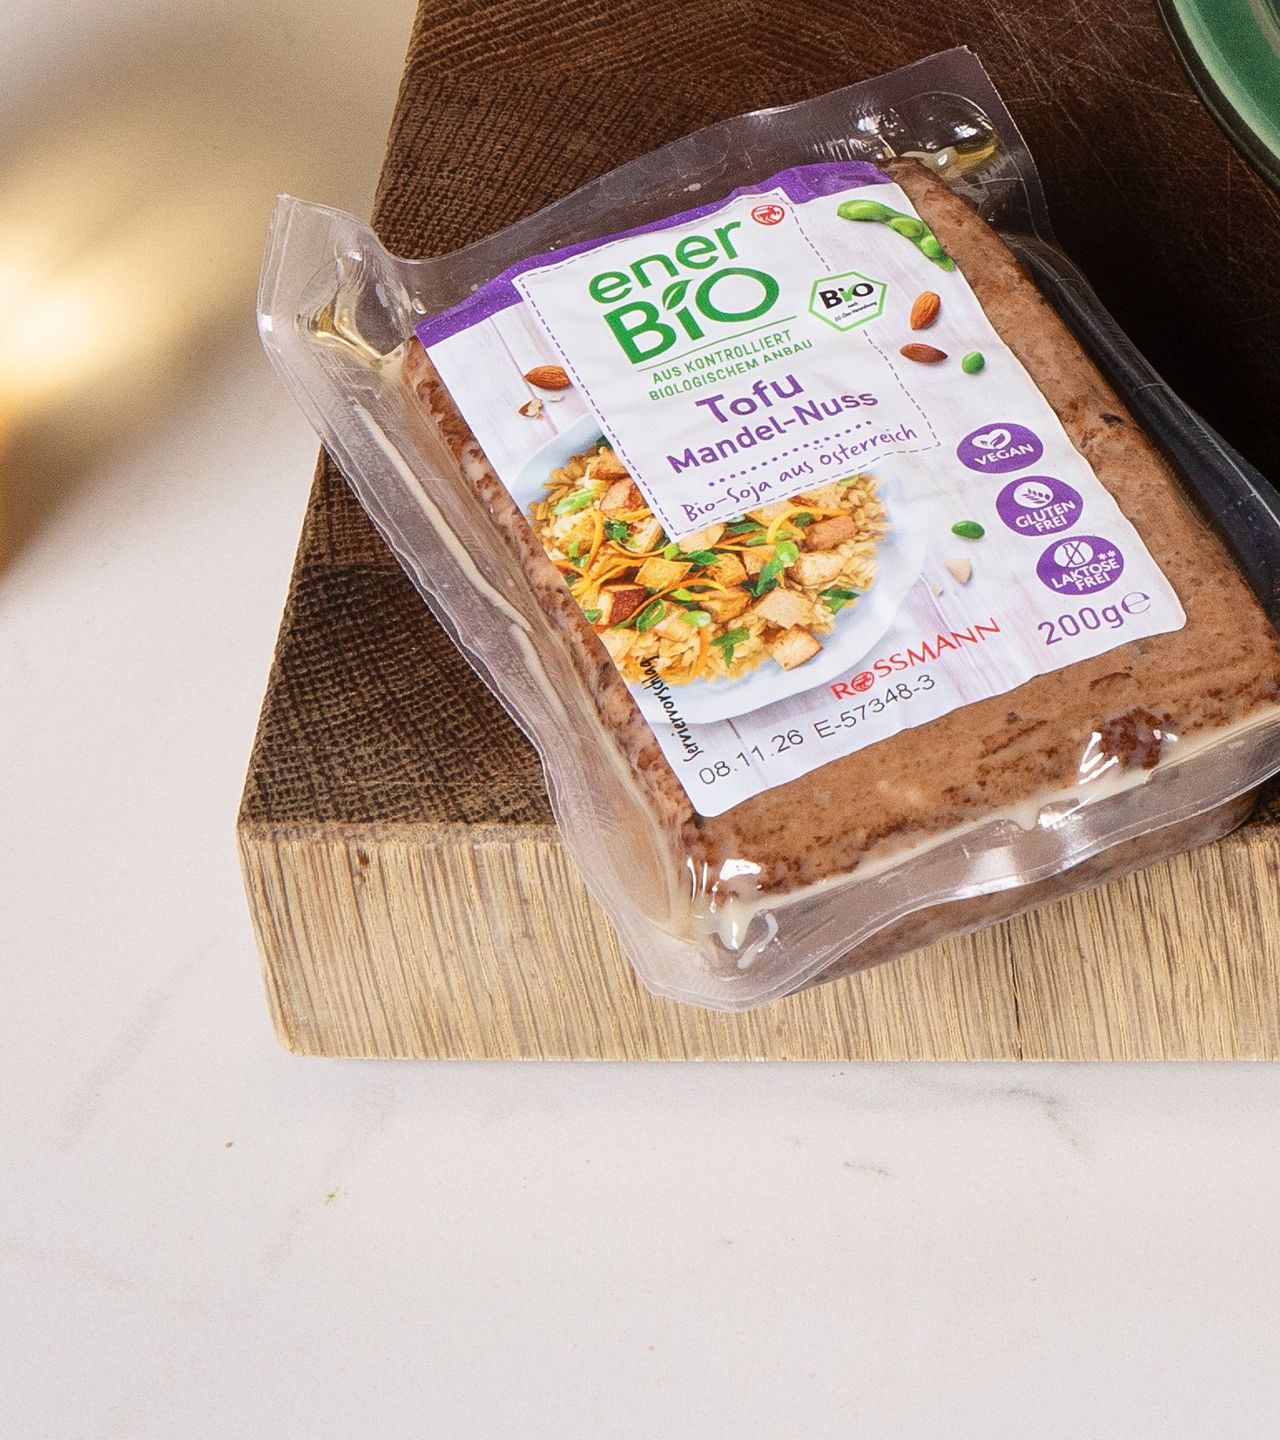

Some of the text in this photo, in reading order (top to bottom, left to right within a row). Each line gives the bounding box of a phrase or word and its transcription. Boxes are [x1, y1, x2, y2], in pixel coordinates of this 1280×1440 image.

[588, 221, 742, 304] ener
[648, 338, 813, 401] BIOLOGISCHEM ANBAU
[652, 329, 794, 385] AUS KONTROLLIERT
[695, 373, 805, 424] Tofu
[666, 392, 879, 474] Mandel-Nuss
[974, 443, 1035, 466] VEGAN
[681, 481, 773, 523] Bio-Soja
[779, 460, 815, 483] aus
[1015, 500, 1076, 529] GLUTEN
[1035, 516, 1068, 533] FREI
[1074, 573, 1110, 592] FREI
[638, 655, 706, 765] Serviervorschlag
[699, 674, 936, 786] 08.11.26 E-57348-3
